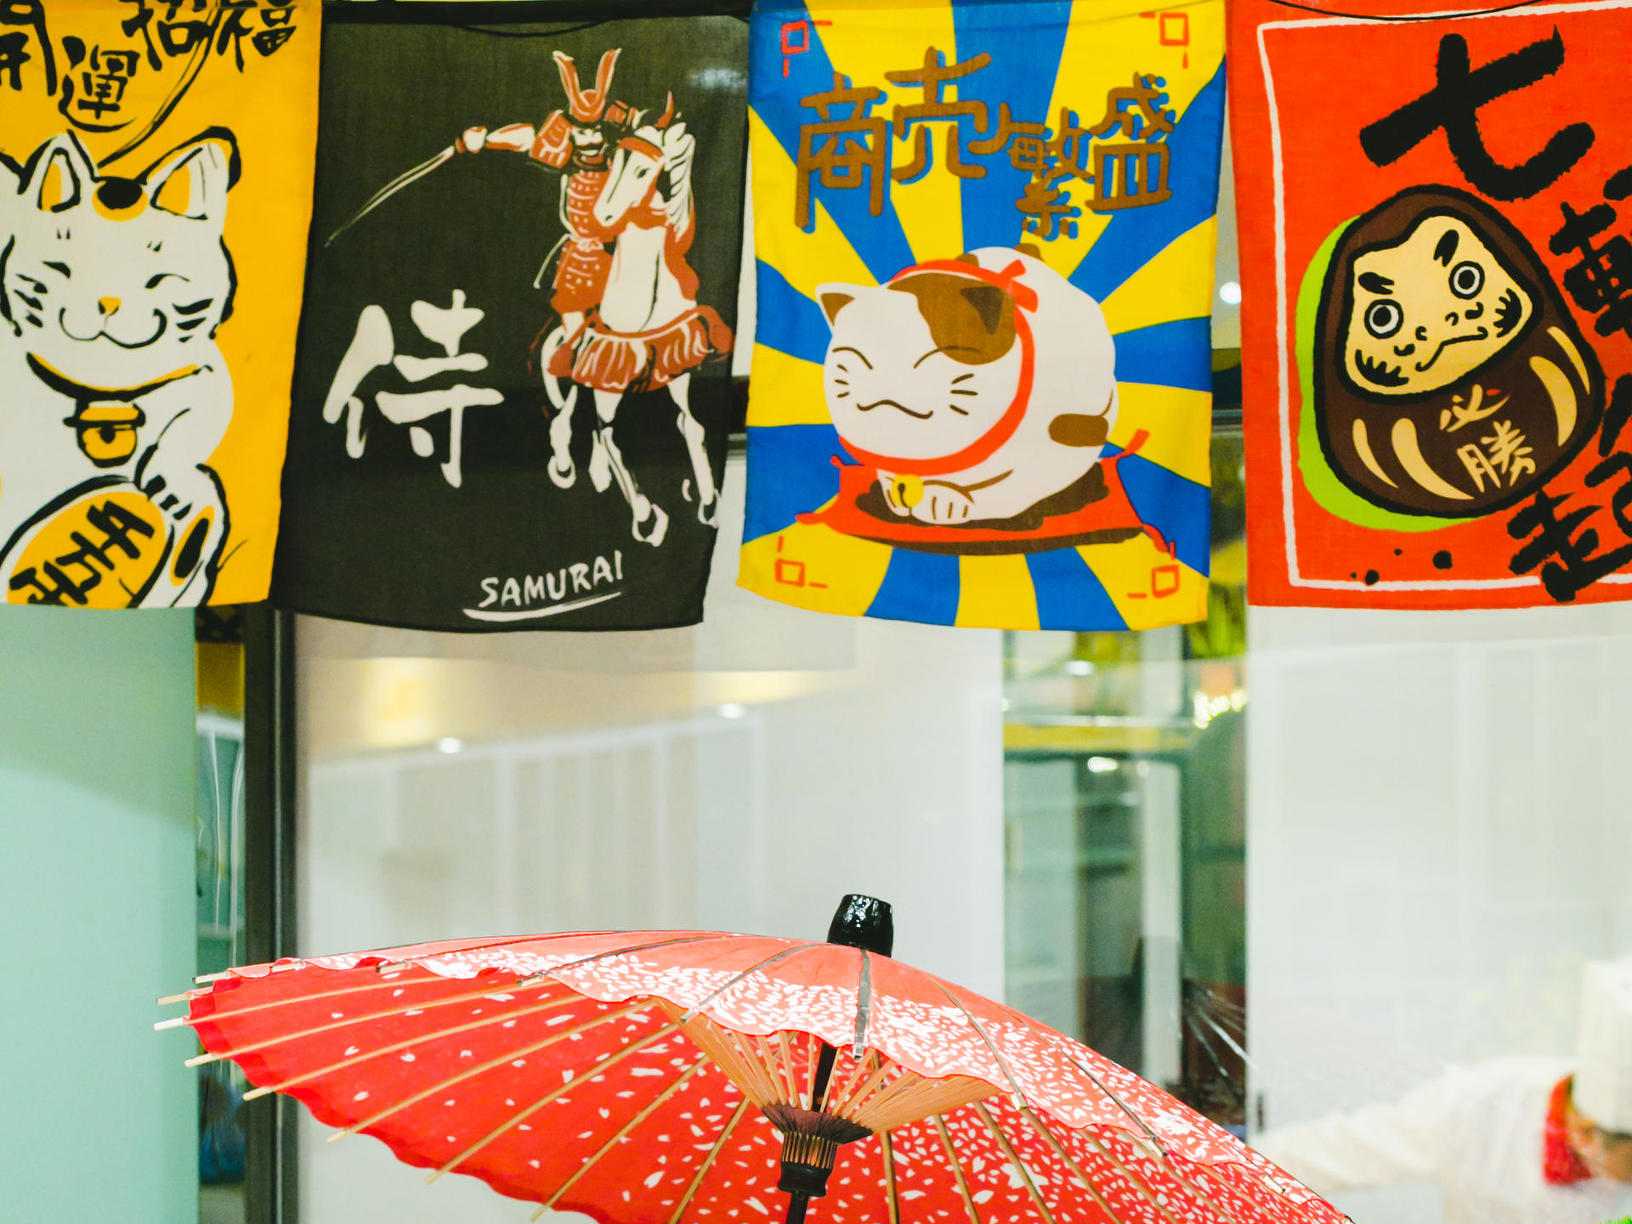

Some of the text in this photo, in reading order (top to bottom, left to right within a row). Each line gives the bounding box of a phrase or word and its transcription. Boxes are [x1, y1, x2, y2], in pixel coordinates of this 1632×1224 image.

[322, 289, 505, 489] 侍
[1439, 384, 1537, 494] 必勝
[478, 549, 624, 609] SAMURAI
